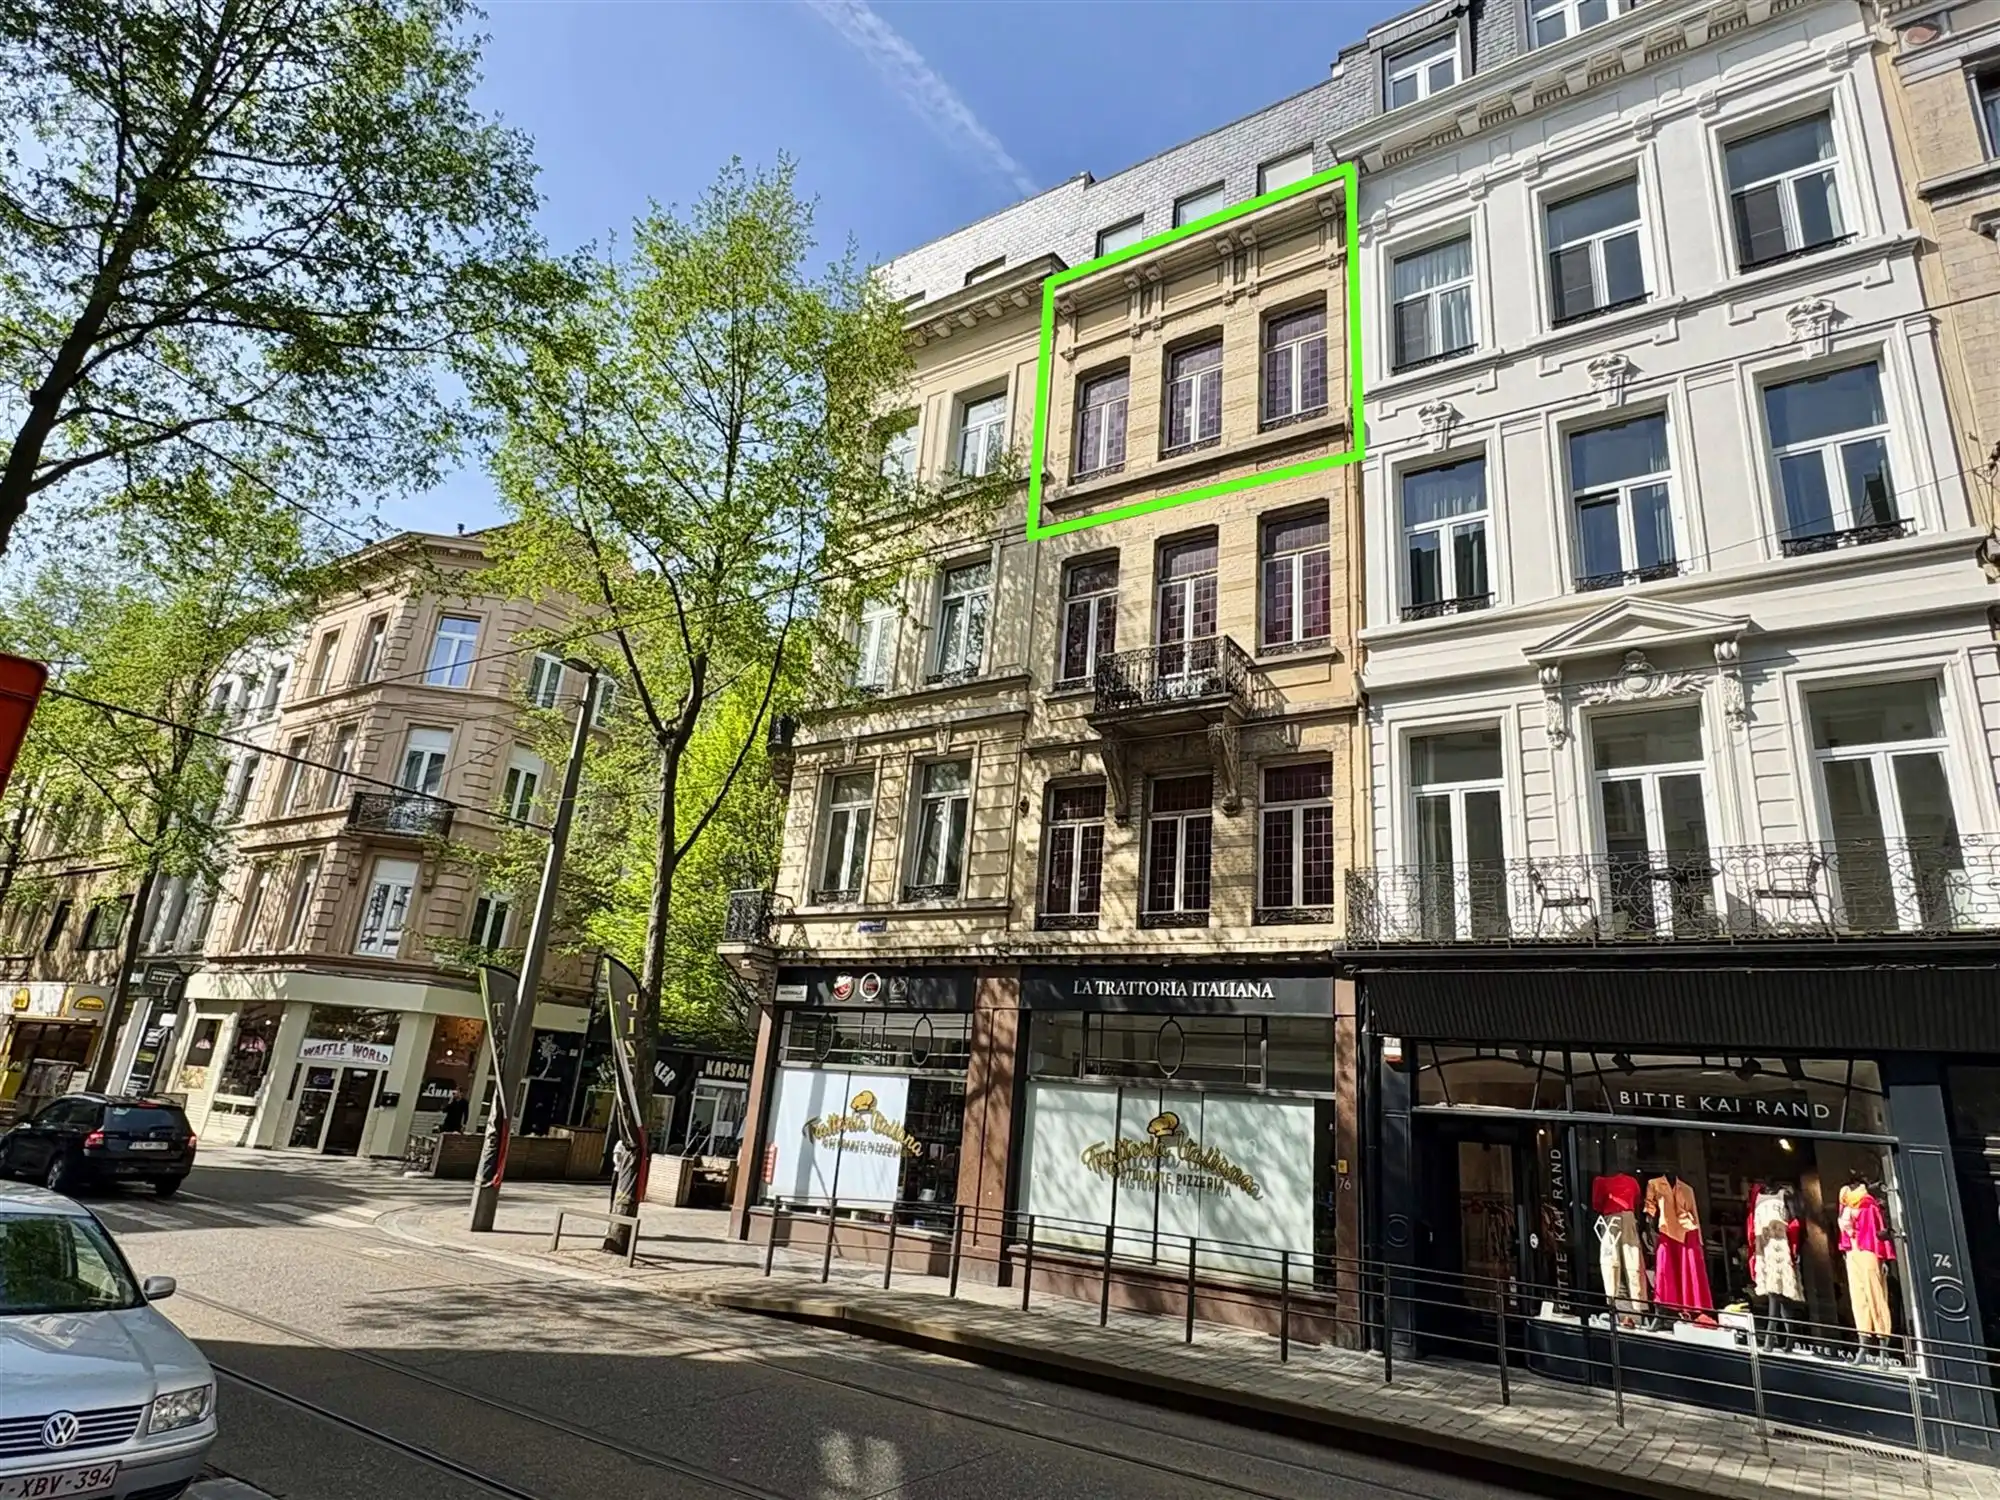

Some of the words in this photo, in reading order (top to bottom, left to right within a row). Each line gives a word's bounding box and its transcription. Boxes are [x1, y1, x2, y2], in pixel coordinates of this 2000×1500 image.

[1073, 980, 1093, 995] LA
[1095, 980, 1188, 997] TRATTORIA
[1191, 982, 1275, 999] ITALIANA
[304, 1042, 347, 1056] WAFFLE
[352, 1044, 389, 1064] WORLD
[1620, 1090, 1686, 1109] BITTE
[1699, 1096, 1741, 1113] KAI
[1756, 1100, 1830, 1119] RAND
[1339, 1177, 1351, 1190] 76
[1551, 1149, 1565, 1200] RAND
[1933, 1254, 1952, 1268] 74
[1837, 1349, 1858, 1360] KA
